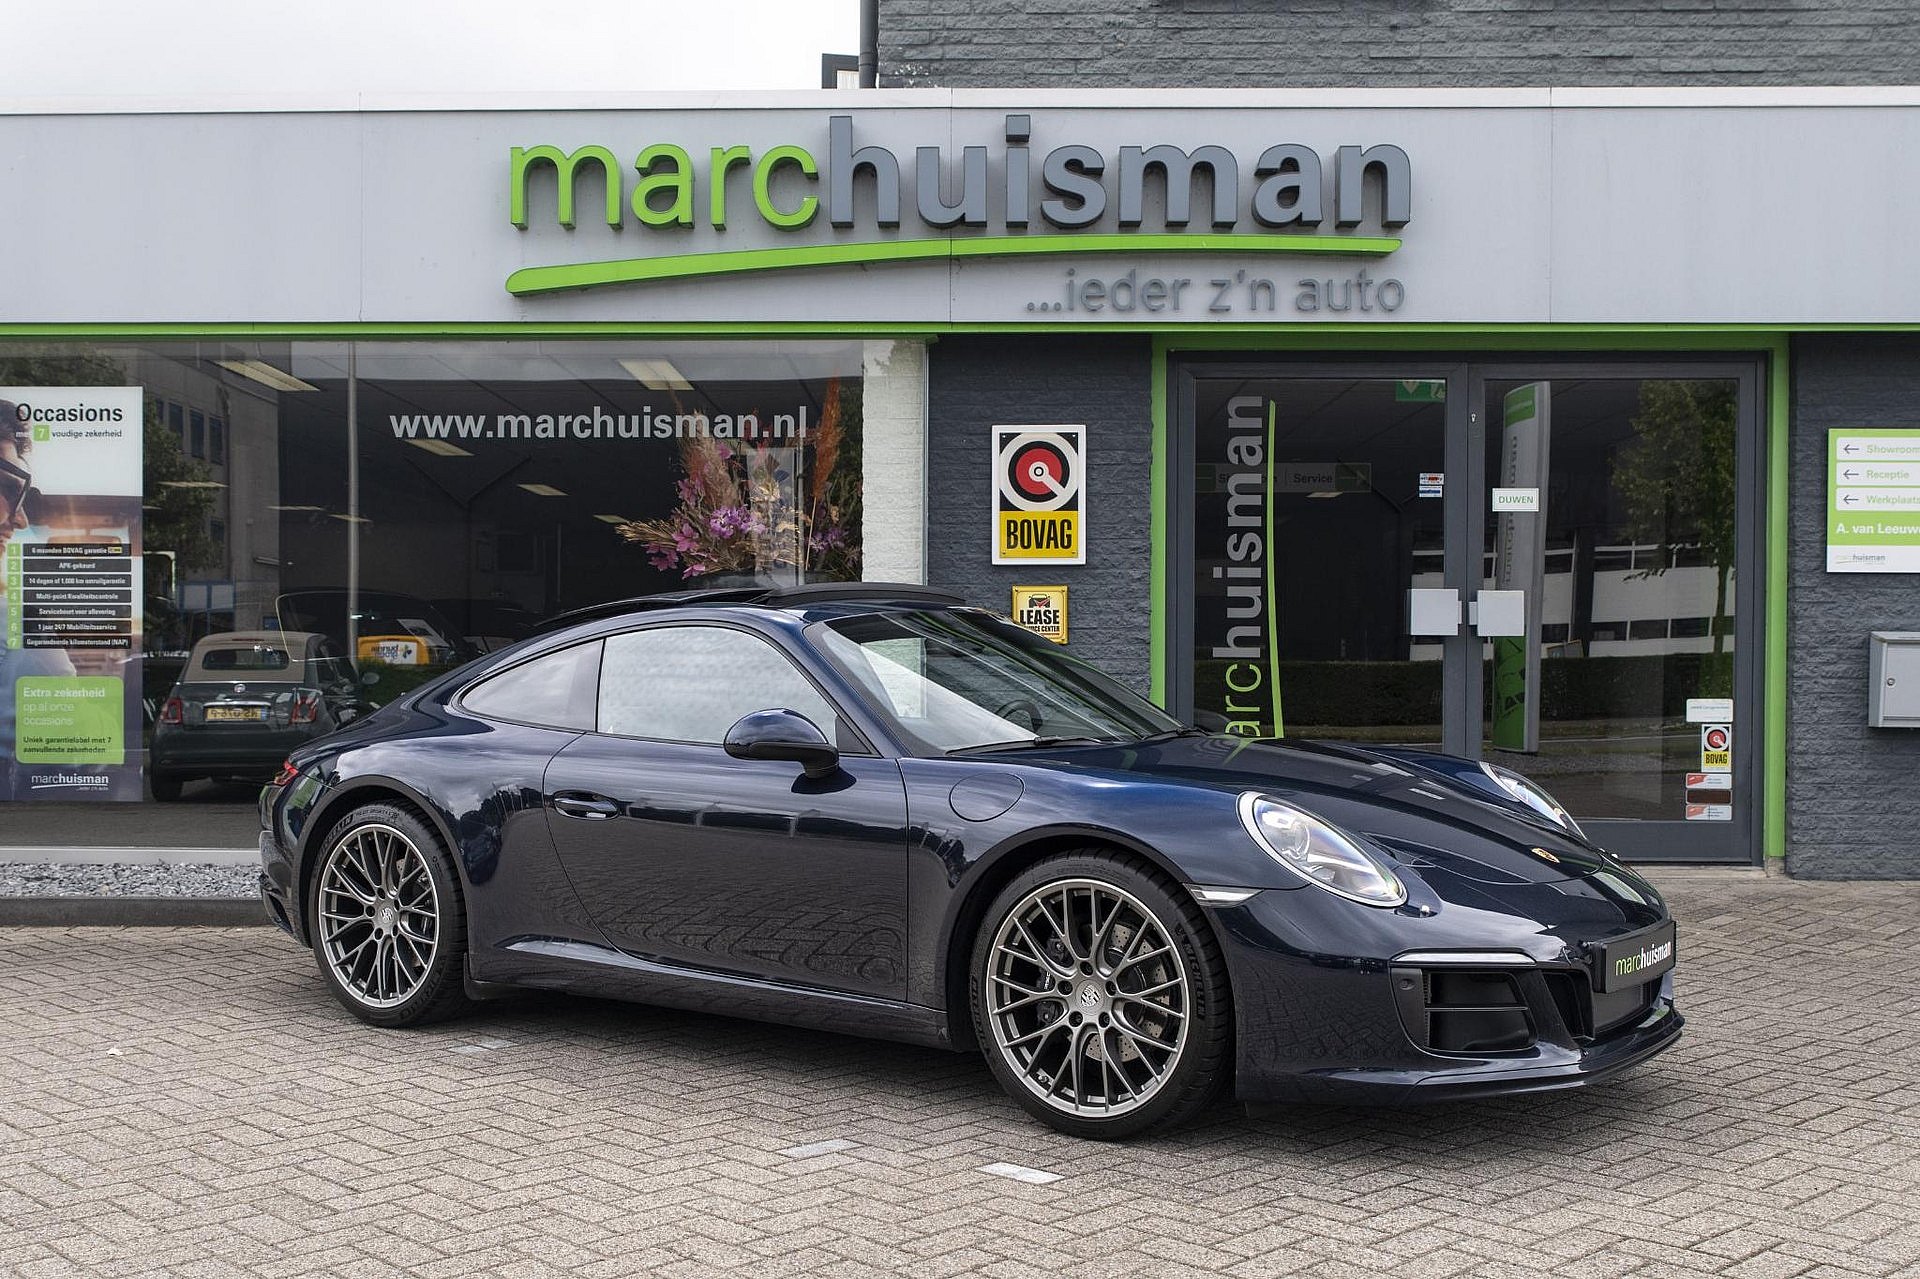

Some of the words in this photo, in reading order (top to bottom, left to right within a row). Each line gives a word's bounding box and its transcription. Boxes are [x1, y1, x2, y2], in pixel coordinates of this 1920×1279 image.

[510, 115, 1411, 231] marchuisman
[1027, 268, 1191, 312] ...ieder
[1209, 269, 1276, 312] z'n
[1295, 268, 1405, 312] auto
[16, 403, 123, 422] Occasions
[390, 406, 808, 439] www.marchuisman.nl
[85, 429, 122, 438] zekerheid
[1867, 469, 1910, 482] Receptie
[1498, 495, 1534, 504] DUWEN
[1006, 519, 1073, 550] BOVAG
[1836, 523, 1849, 534] A.
[1852, 526, 1874, 534] van
[1213, 396, 1263, 737] archuisman
[1019, 609, 1060, 625] LEASE
[23, 687, 51, 698] Extra
[54, 687, 106, 698] zekerheid
[1705, 752, 1729, 764] BOVAG
[31, 773, 109, 784] marchuisman
[1615, 941, 1672, 976] marchuisman
